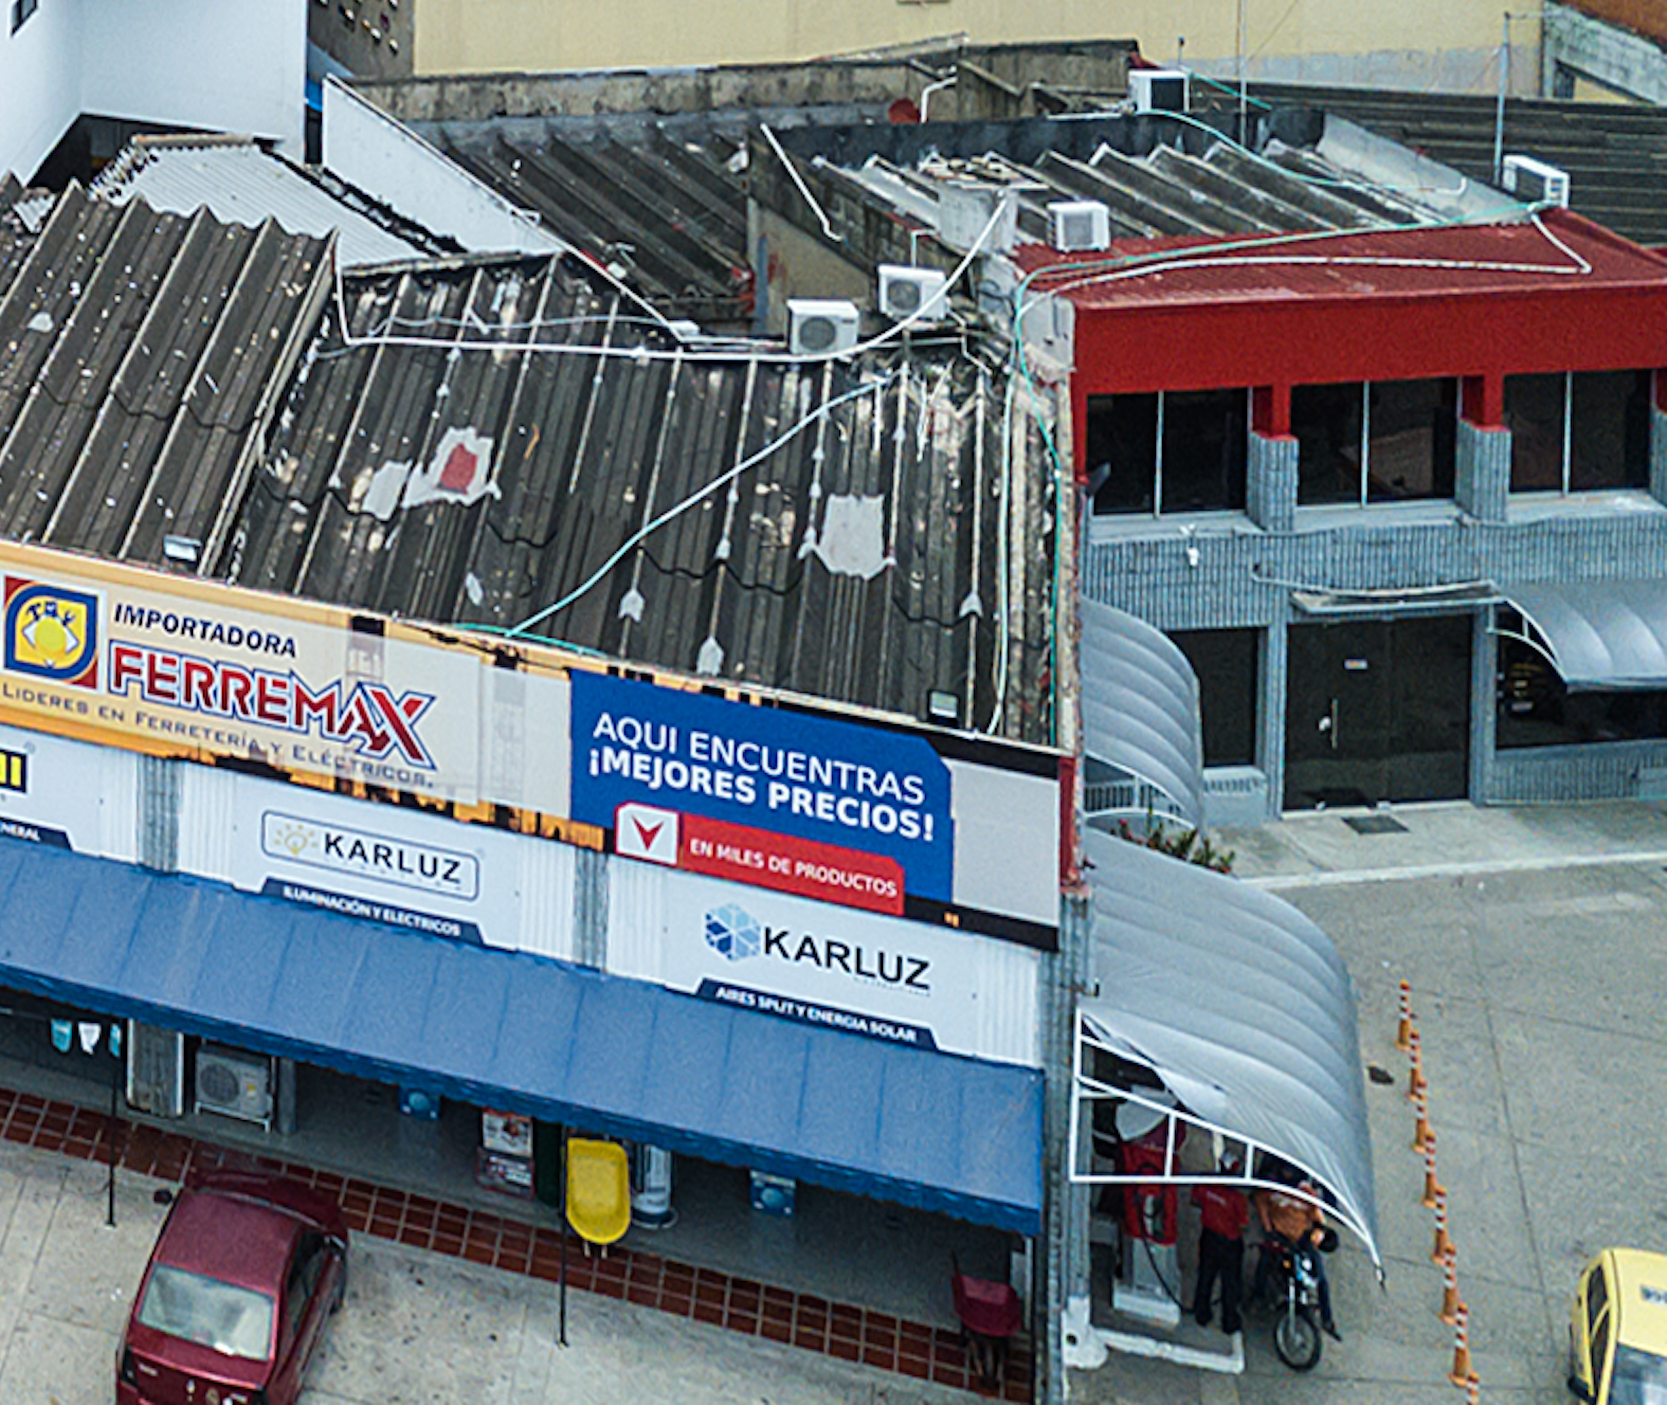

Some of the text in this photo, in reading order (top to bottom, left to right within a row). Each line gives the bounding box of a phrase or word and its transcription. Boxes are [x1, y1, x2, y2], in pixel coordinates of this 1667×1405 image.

[114, 602, 297, 658] IMPORTADORA
[109, 640, 436, 769] FERREMAX
[592, 712, 925, 806] AQUI ENCUENTRAS
[589, 747, 935, 842] ¡MEJORES PRECIOS!
[324, 831, 462, 884] KARLUZ
[690, 838, 898, 898] EN MILES DE PRODUCTOS
[372, 907, 383, 921] Y
[383, 908, 461, 937] ELECTRICOS
[764, 926, 930, 991] KARLUZ
[716, 986, 916, 1043] AIRES SPLIT Y ENERGIA SOLAR
